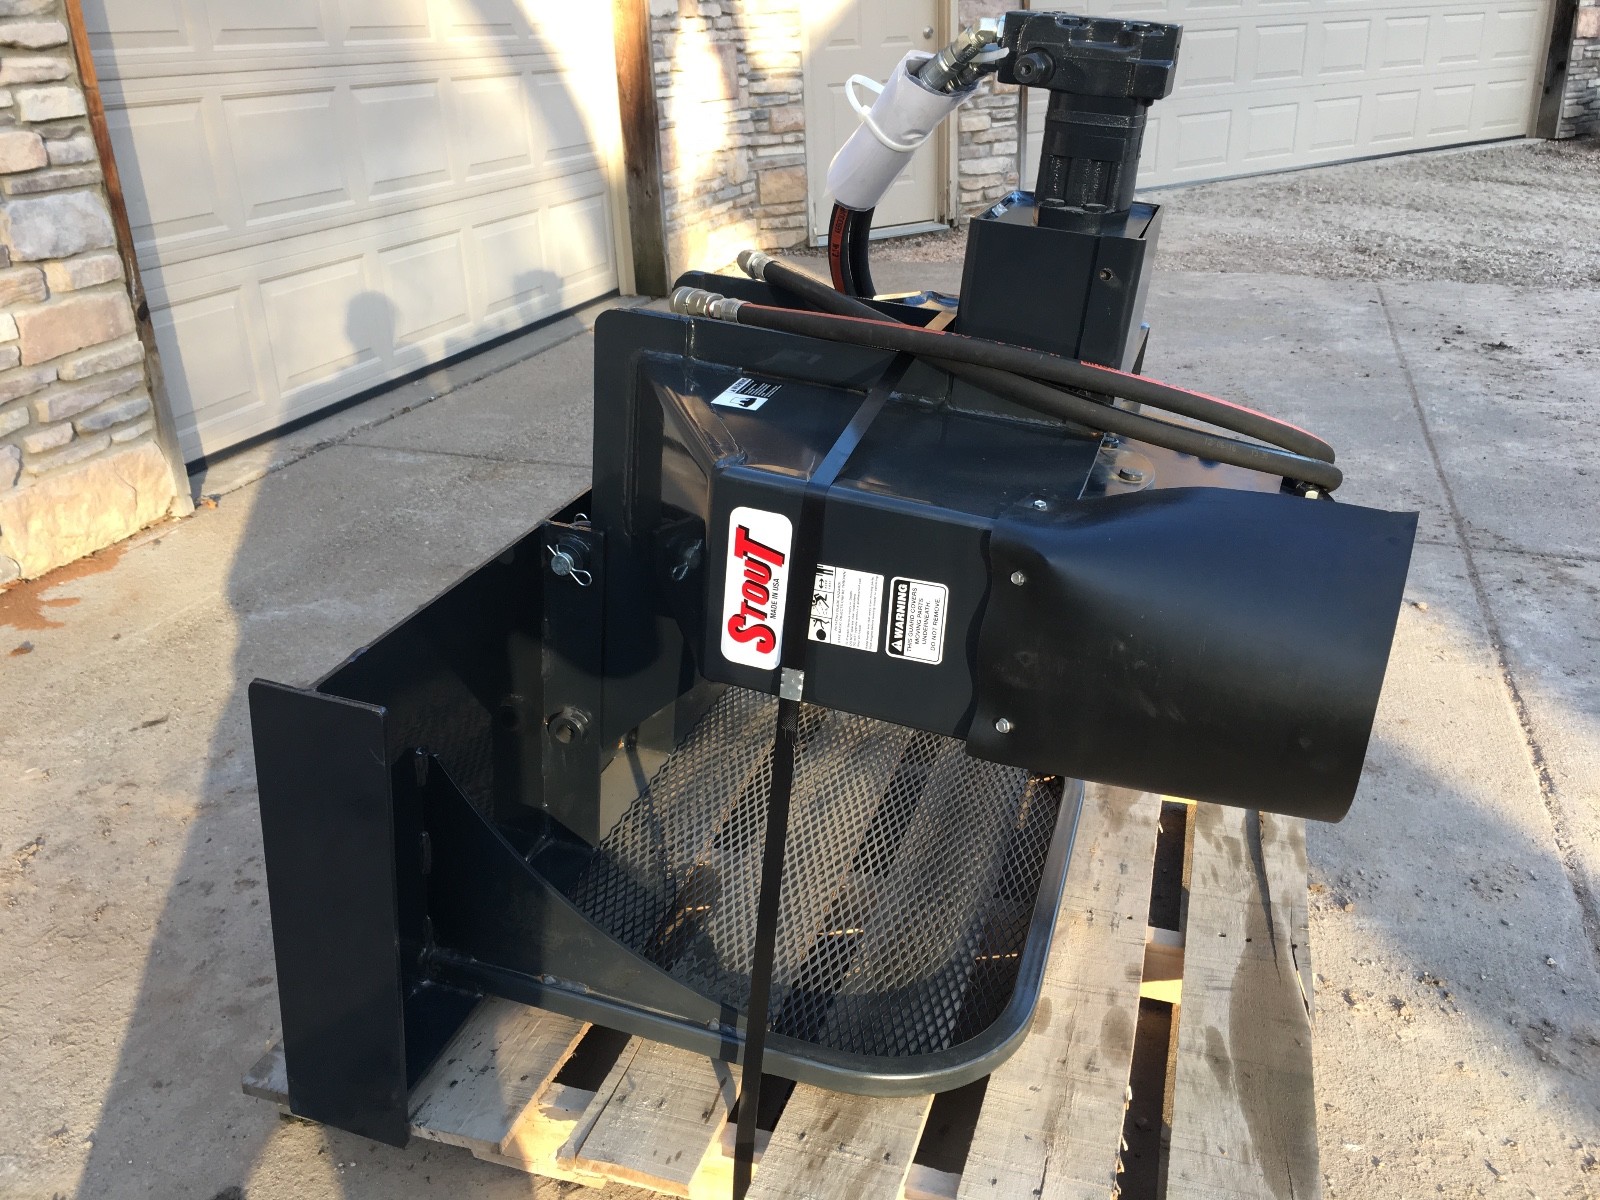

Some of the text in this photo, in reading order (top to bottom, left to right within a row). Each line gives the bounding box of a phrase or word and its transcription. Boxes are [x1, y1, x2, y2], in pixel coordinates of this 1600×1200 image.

[770, 599, 778, 619] MADE
[772, 591, 779, 599] IN
[894, 584, 908, 639] WARNING
[922, 600, 931, 645] UNDERNEATH.
[930, 641, 936, 651] DO
[933, 598, 941, 626] REMOVE.
